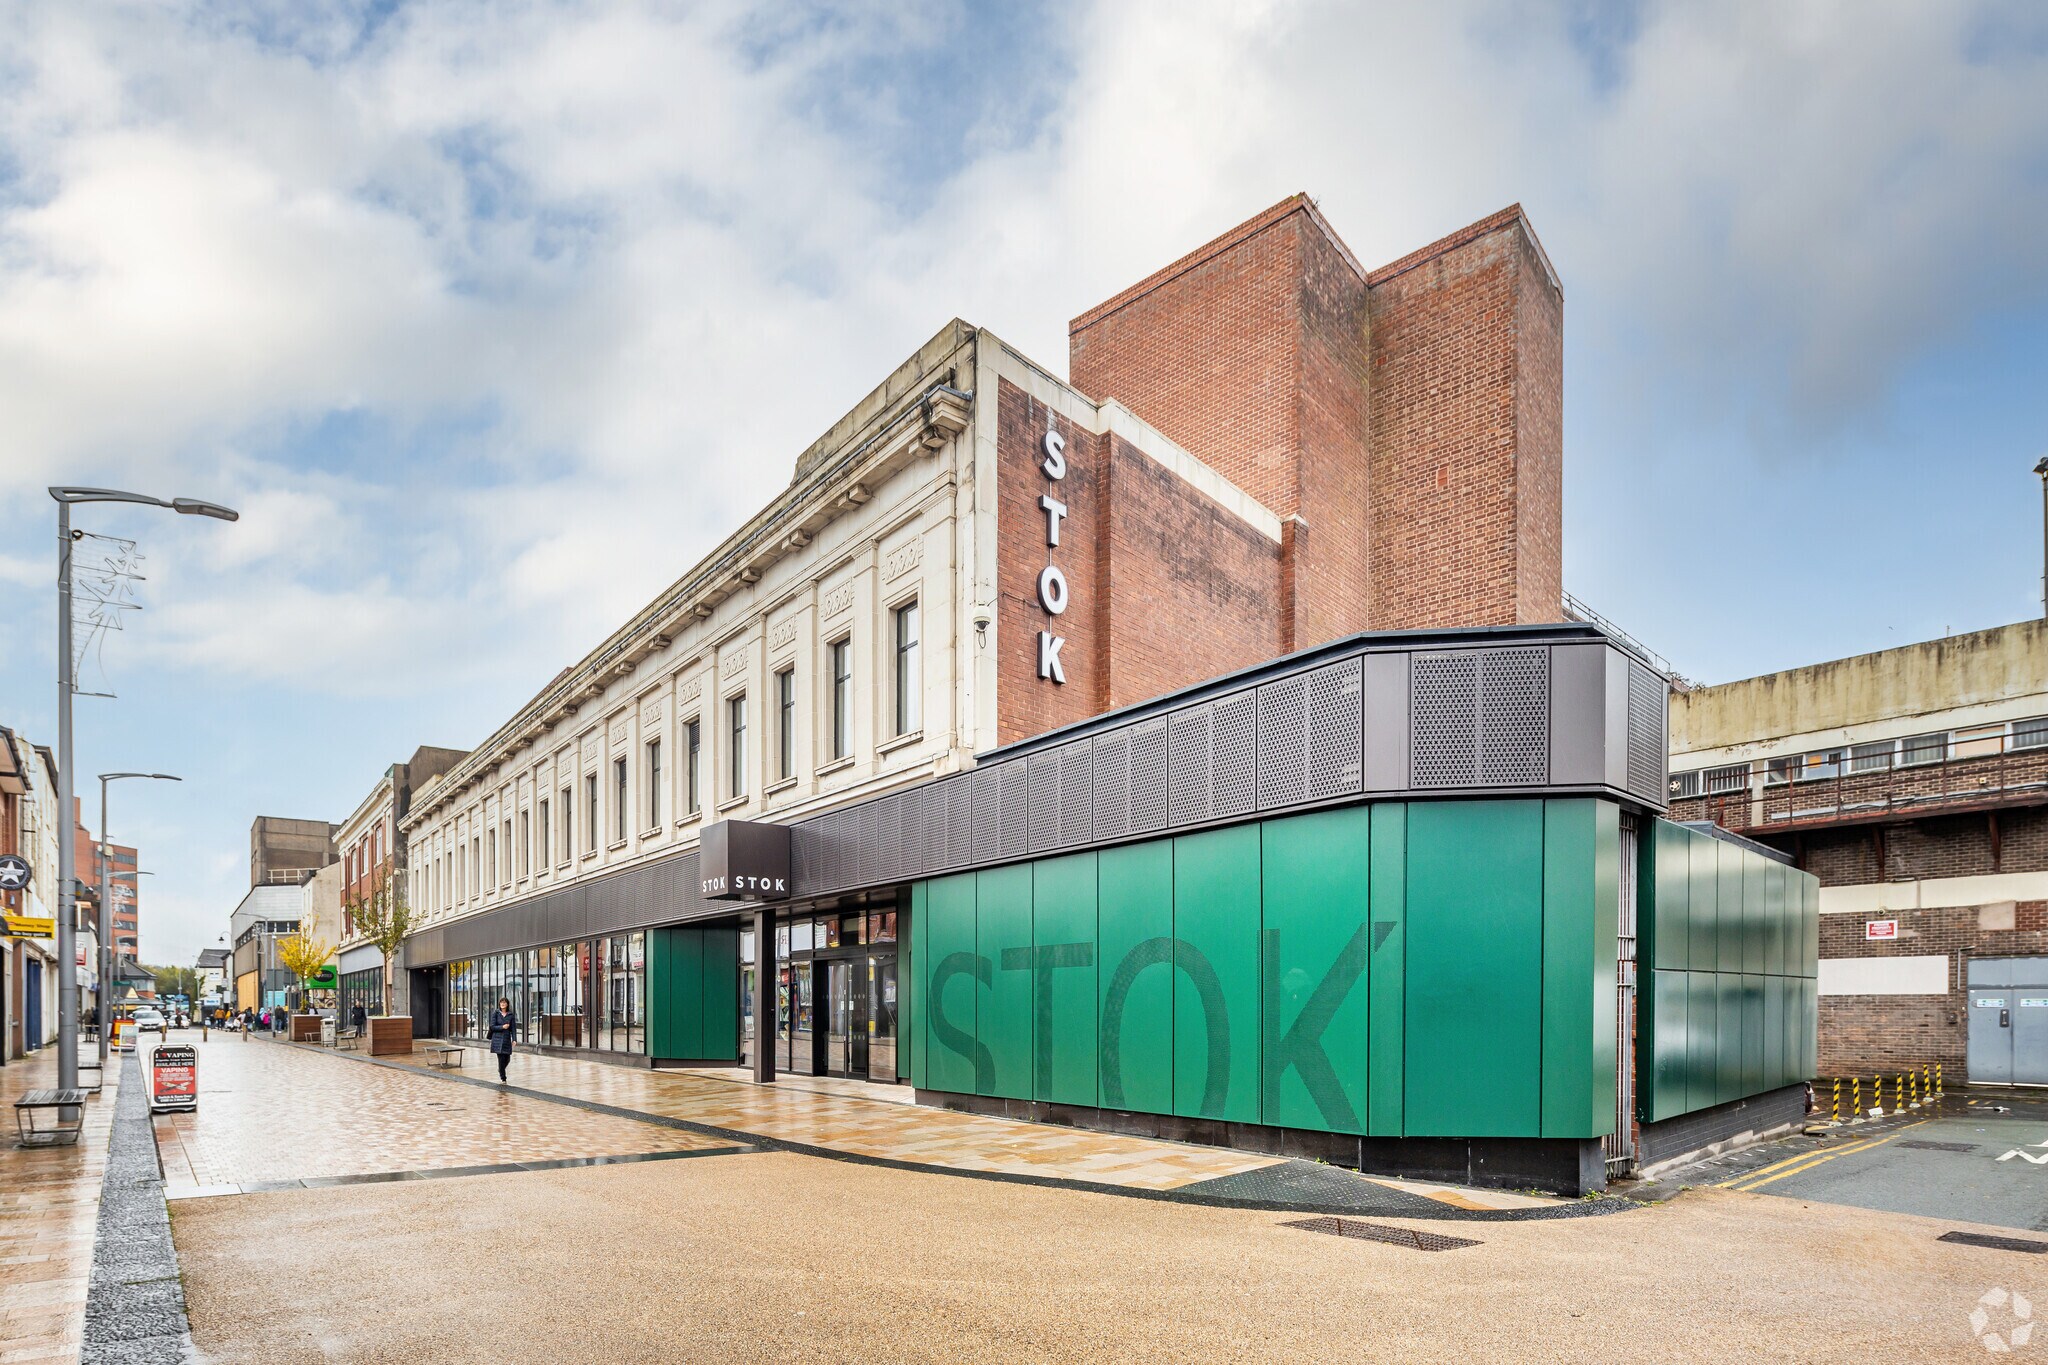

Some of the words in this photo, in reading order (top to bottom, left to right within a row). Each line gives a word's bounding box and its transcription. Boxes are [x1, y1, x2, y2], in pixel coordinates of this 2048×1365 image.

[1037, 430, 1069, 685] STOK
[702, 876, 725, 893] STOK
[735, 876, 785, 891] STOK
[930, 920, 1398, 1133] STOK
